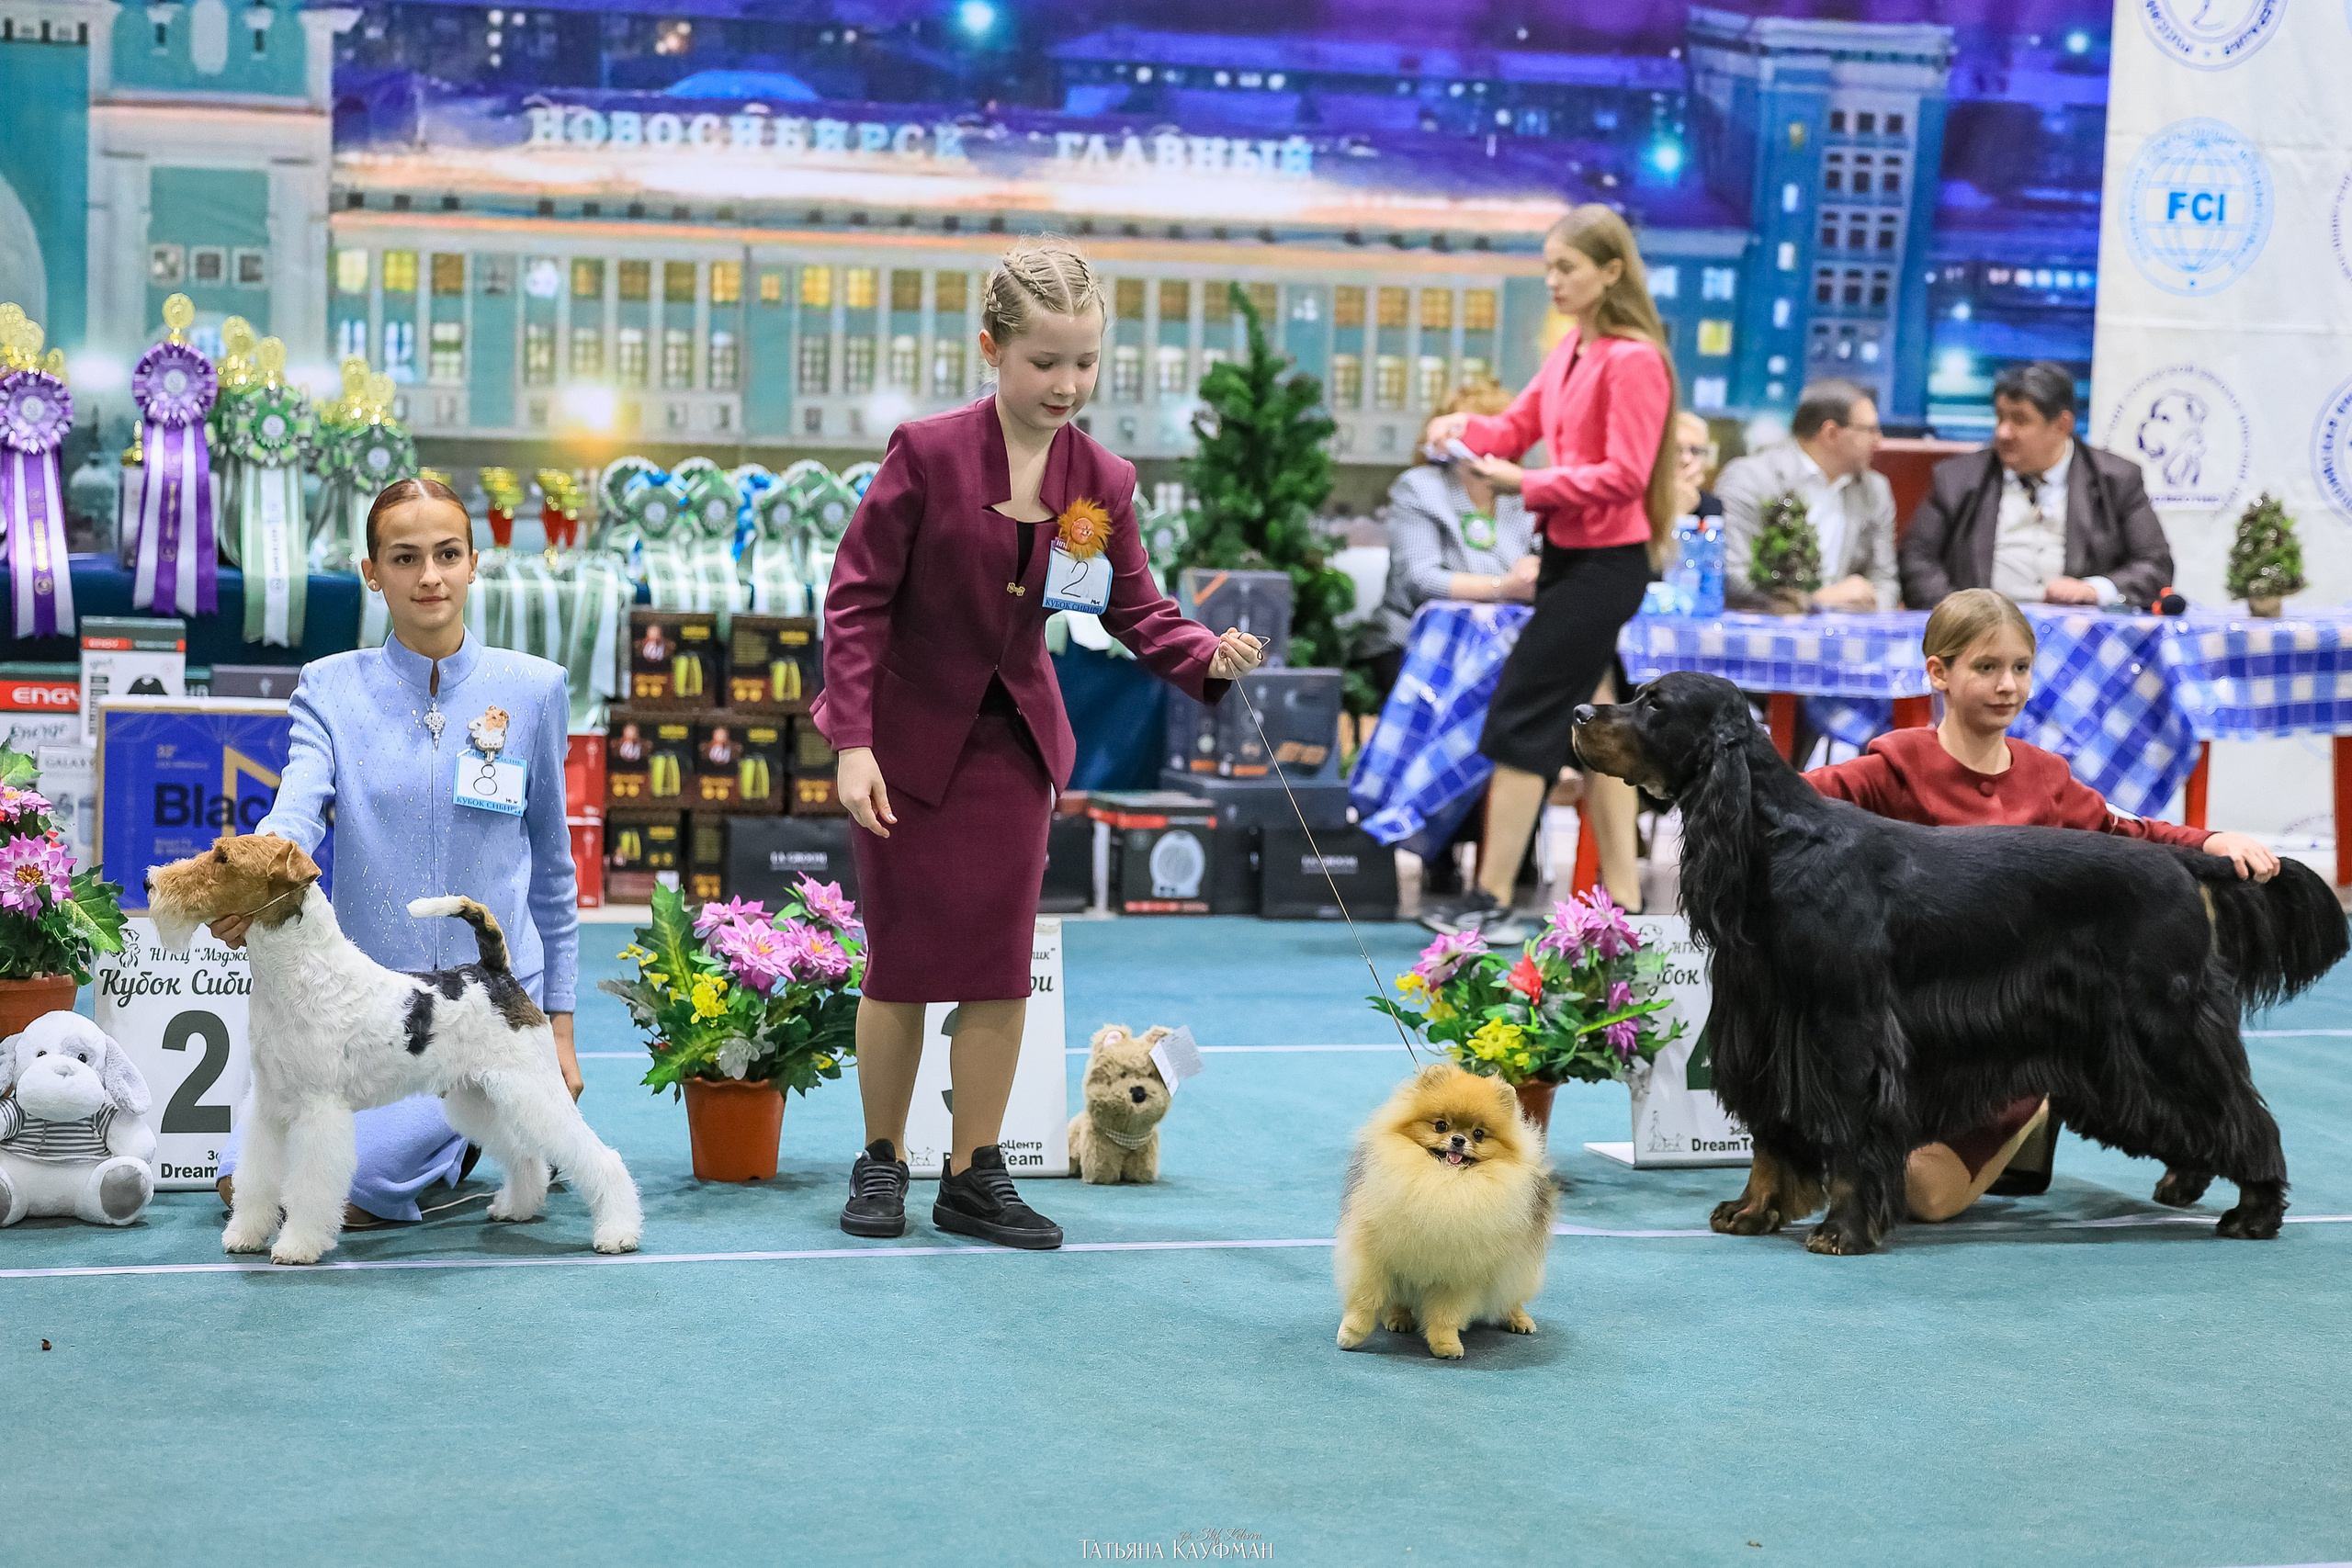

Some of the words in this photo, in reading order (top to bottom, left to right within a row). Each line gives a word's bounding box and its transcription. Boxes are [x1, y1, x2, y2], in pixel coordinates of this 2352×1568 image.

[528, 103, 965, 160] НОВОСИБИРСК
[1055, 131, 1314, 178] ГЛАВНЫЙ
[2167, 191, 2225, 221] FCI
[1060, 560, 1089, 598] 2
[472, 763, 498, 796] 8
[154, 784, 279, 828] Blac
[457, 796, 485, 807] КУБОК
[99, 968, 182, 1009] Кубок
[160, 1010, 232, 1134] 2
[1691, 1137, 1754, 1152] DreamT
[161, 1163, 219, 1179] Dream
